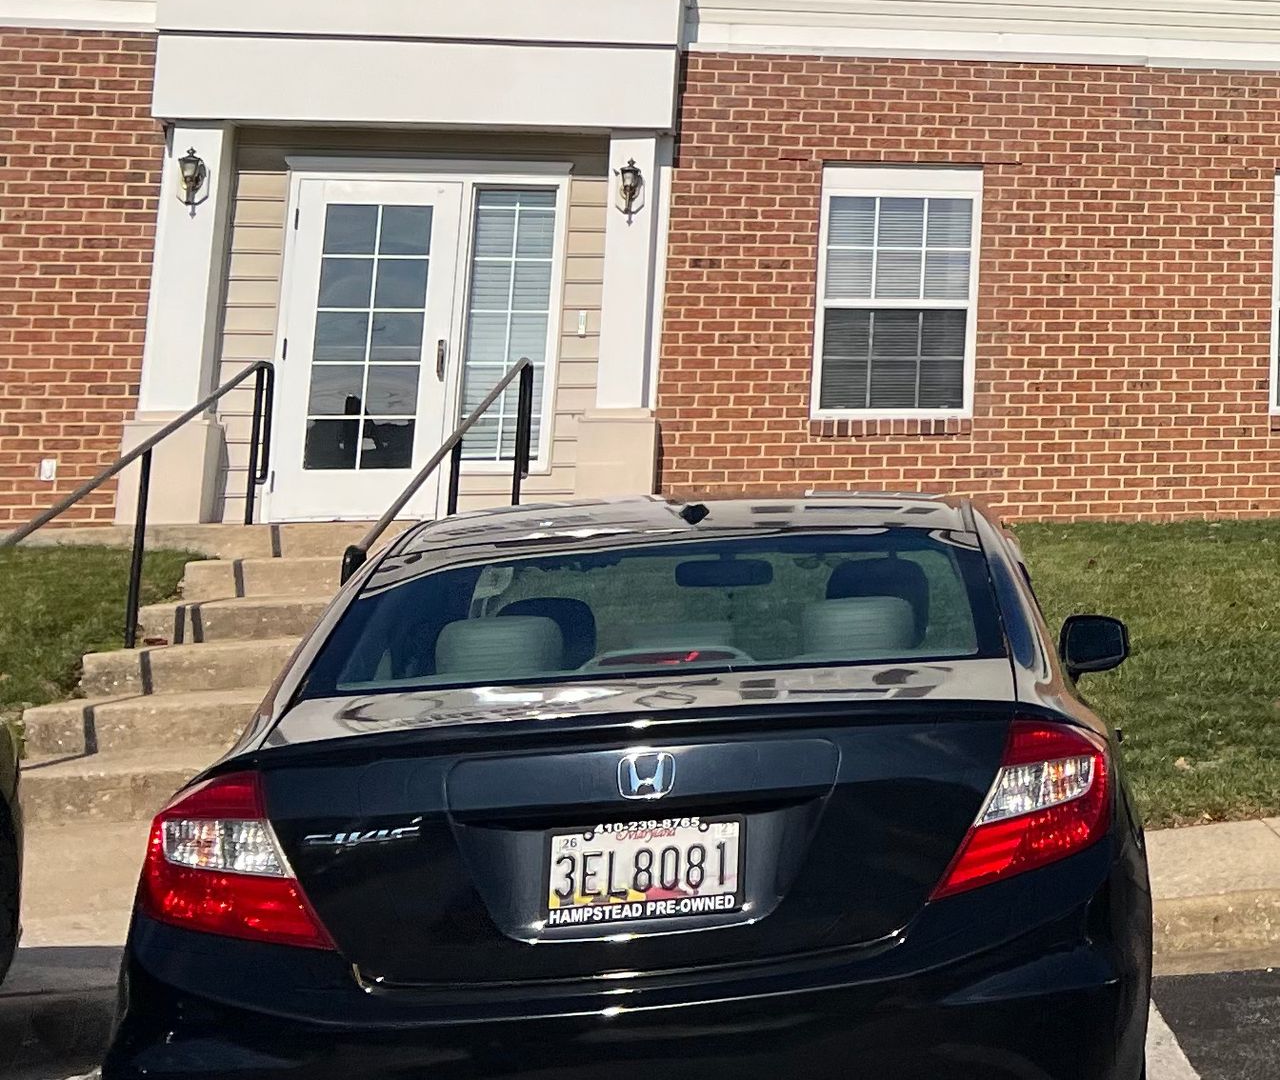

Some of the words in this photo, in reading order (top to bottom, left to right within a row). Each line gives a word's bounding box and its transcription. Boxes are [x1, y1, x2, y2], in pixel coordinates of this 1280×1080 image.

[594, 817, 701, 834] 410-239-8765
[562, 836, 577, 849] 26
[554, 841, 727, 899] 3EL8081
[549, 902, 643, 925] HAMPSTEAD
[646, 895, 735, 916] PRE-OWNED
